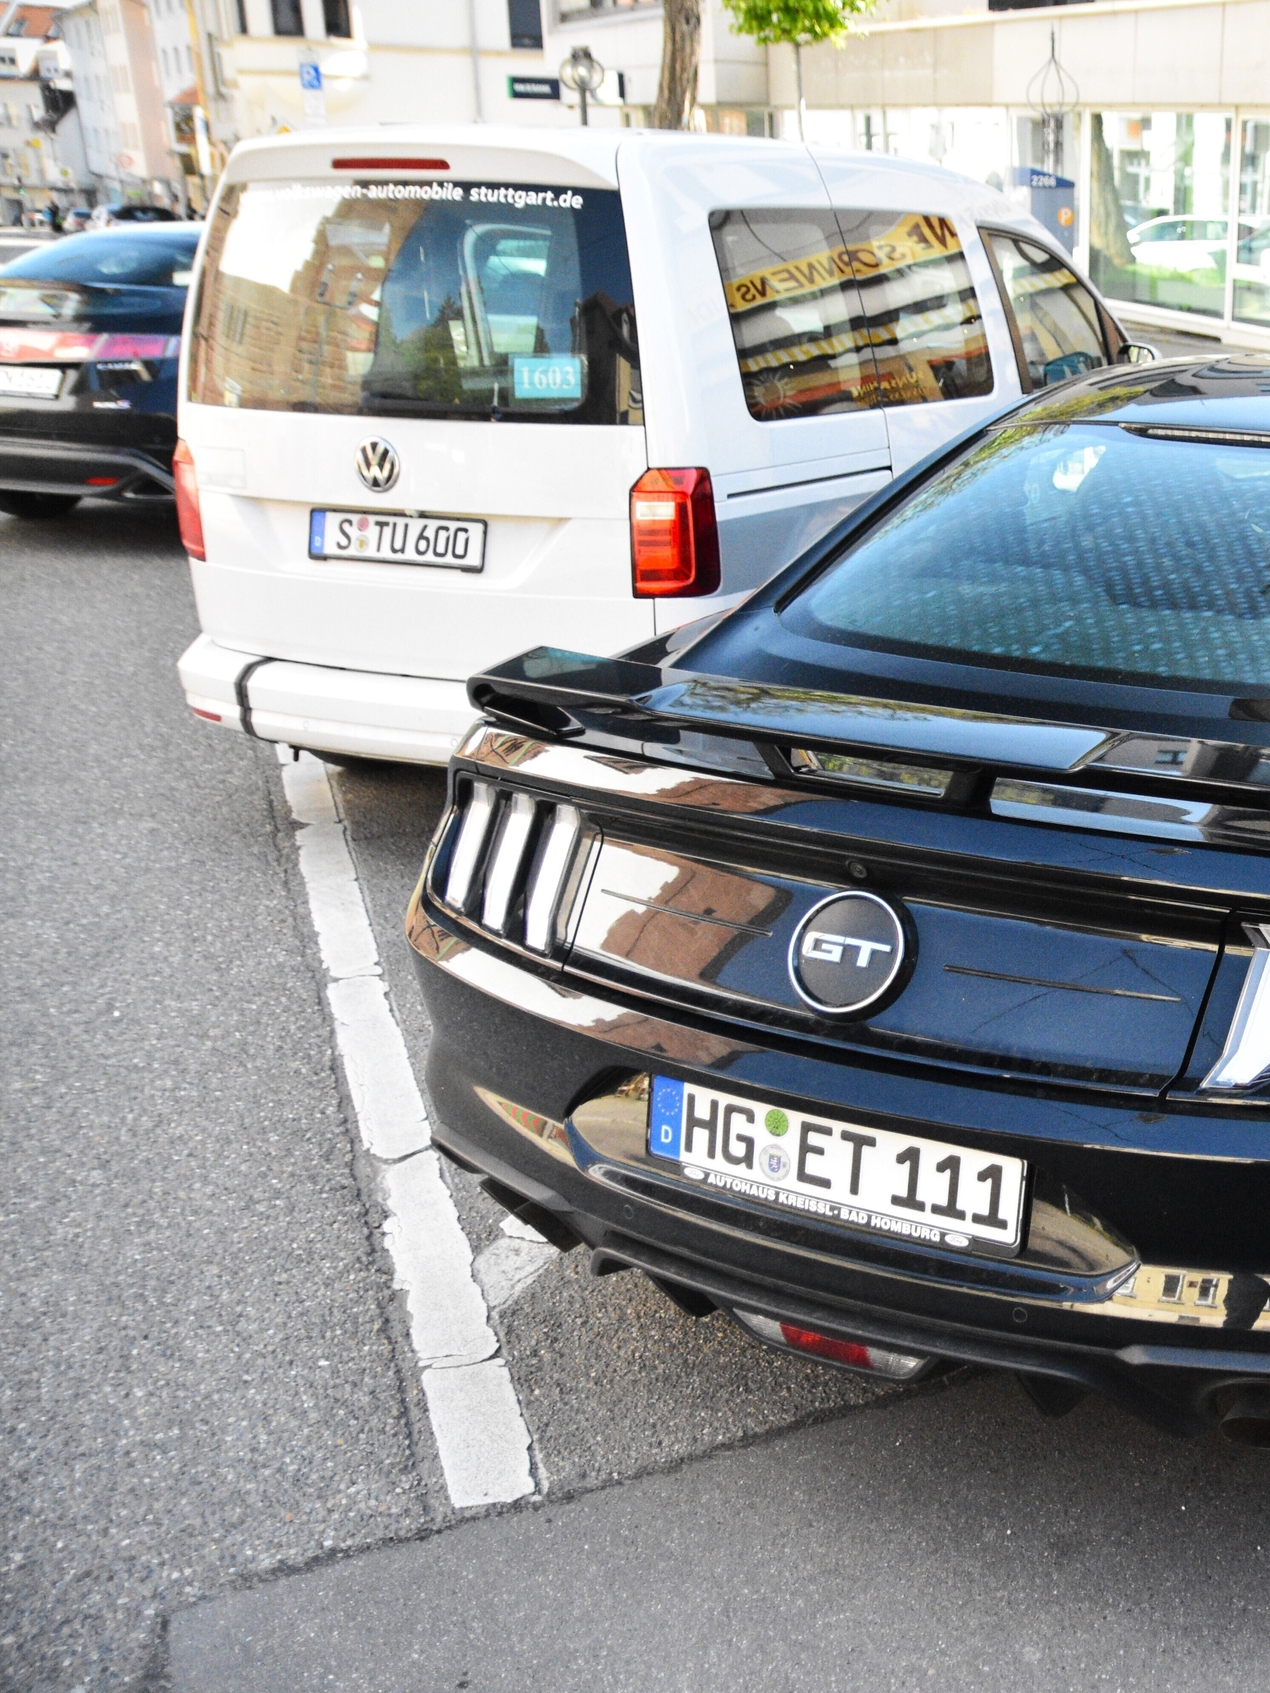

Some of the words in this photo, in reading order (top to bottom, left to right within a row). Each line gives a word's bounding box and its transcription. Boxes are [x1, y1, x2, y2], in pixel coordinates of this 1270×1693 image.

[469, 186, 583, 209] stuttgart.de
[520, 365, 576, 390] 1603
[336, 518, 353, 550] S
[374, 521, 409, 554] TU
[415, 524, 469, 560] 600
[801, 931, 892, 968] GT
[660, 1124, 673, 1144] D
[684, 1092, 756, 1171] HG
[796, 1120, 877, 1196] ET
[890, 1145, 1009, 1231] 111
[707, 1173, 776, 1201] AUTOHAUS
[840, 1208, 868, 1224] BAD
[871, 1216, 940, 1242] HOMBURG
